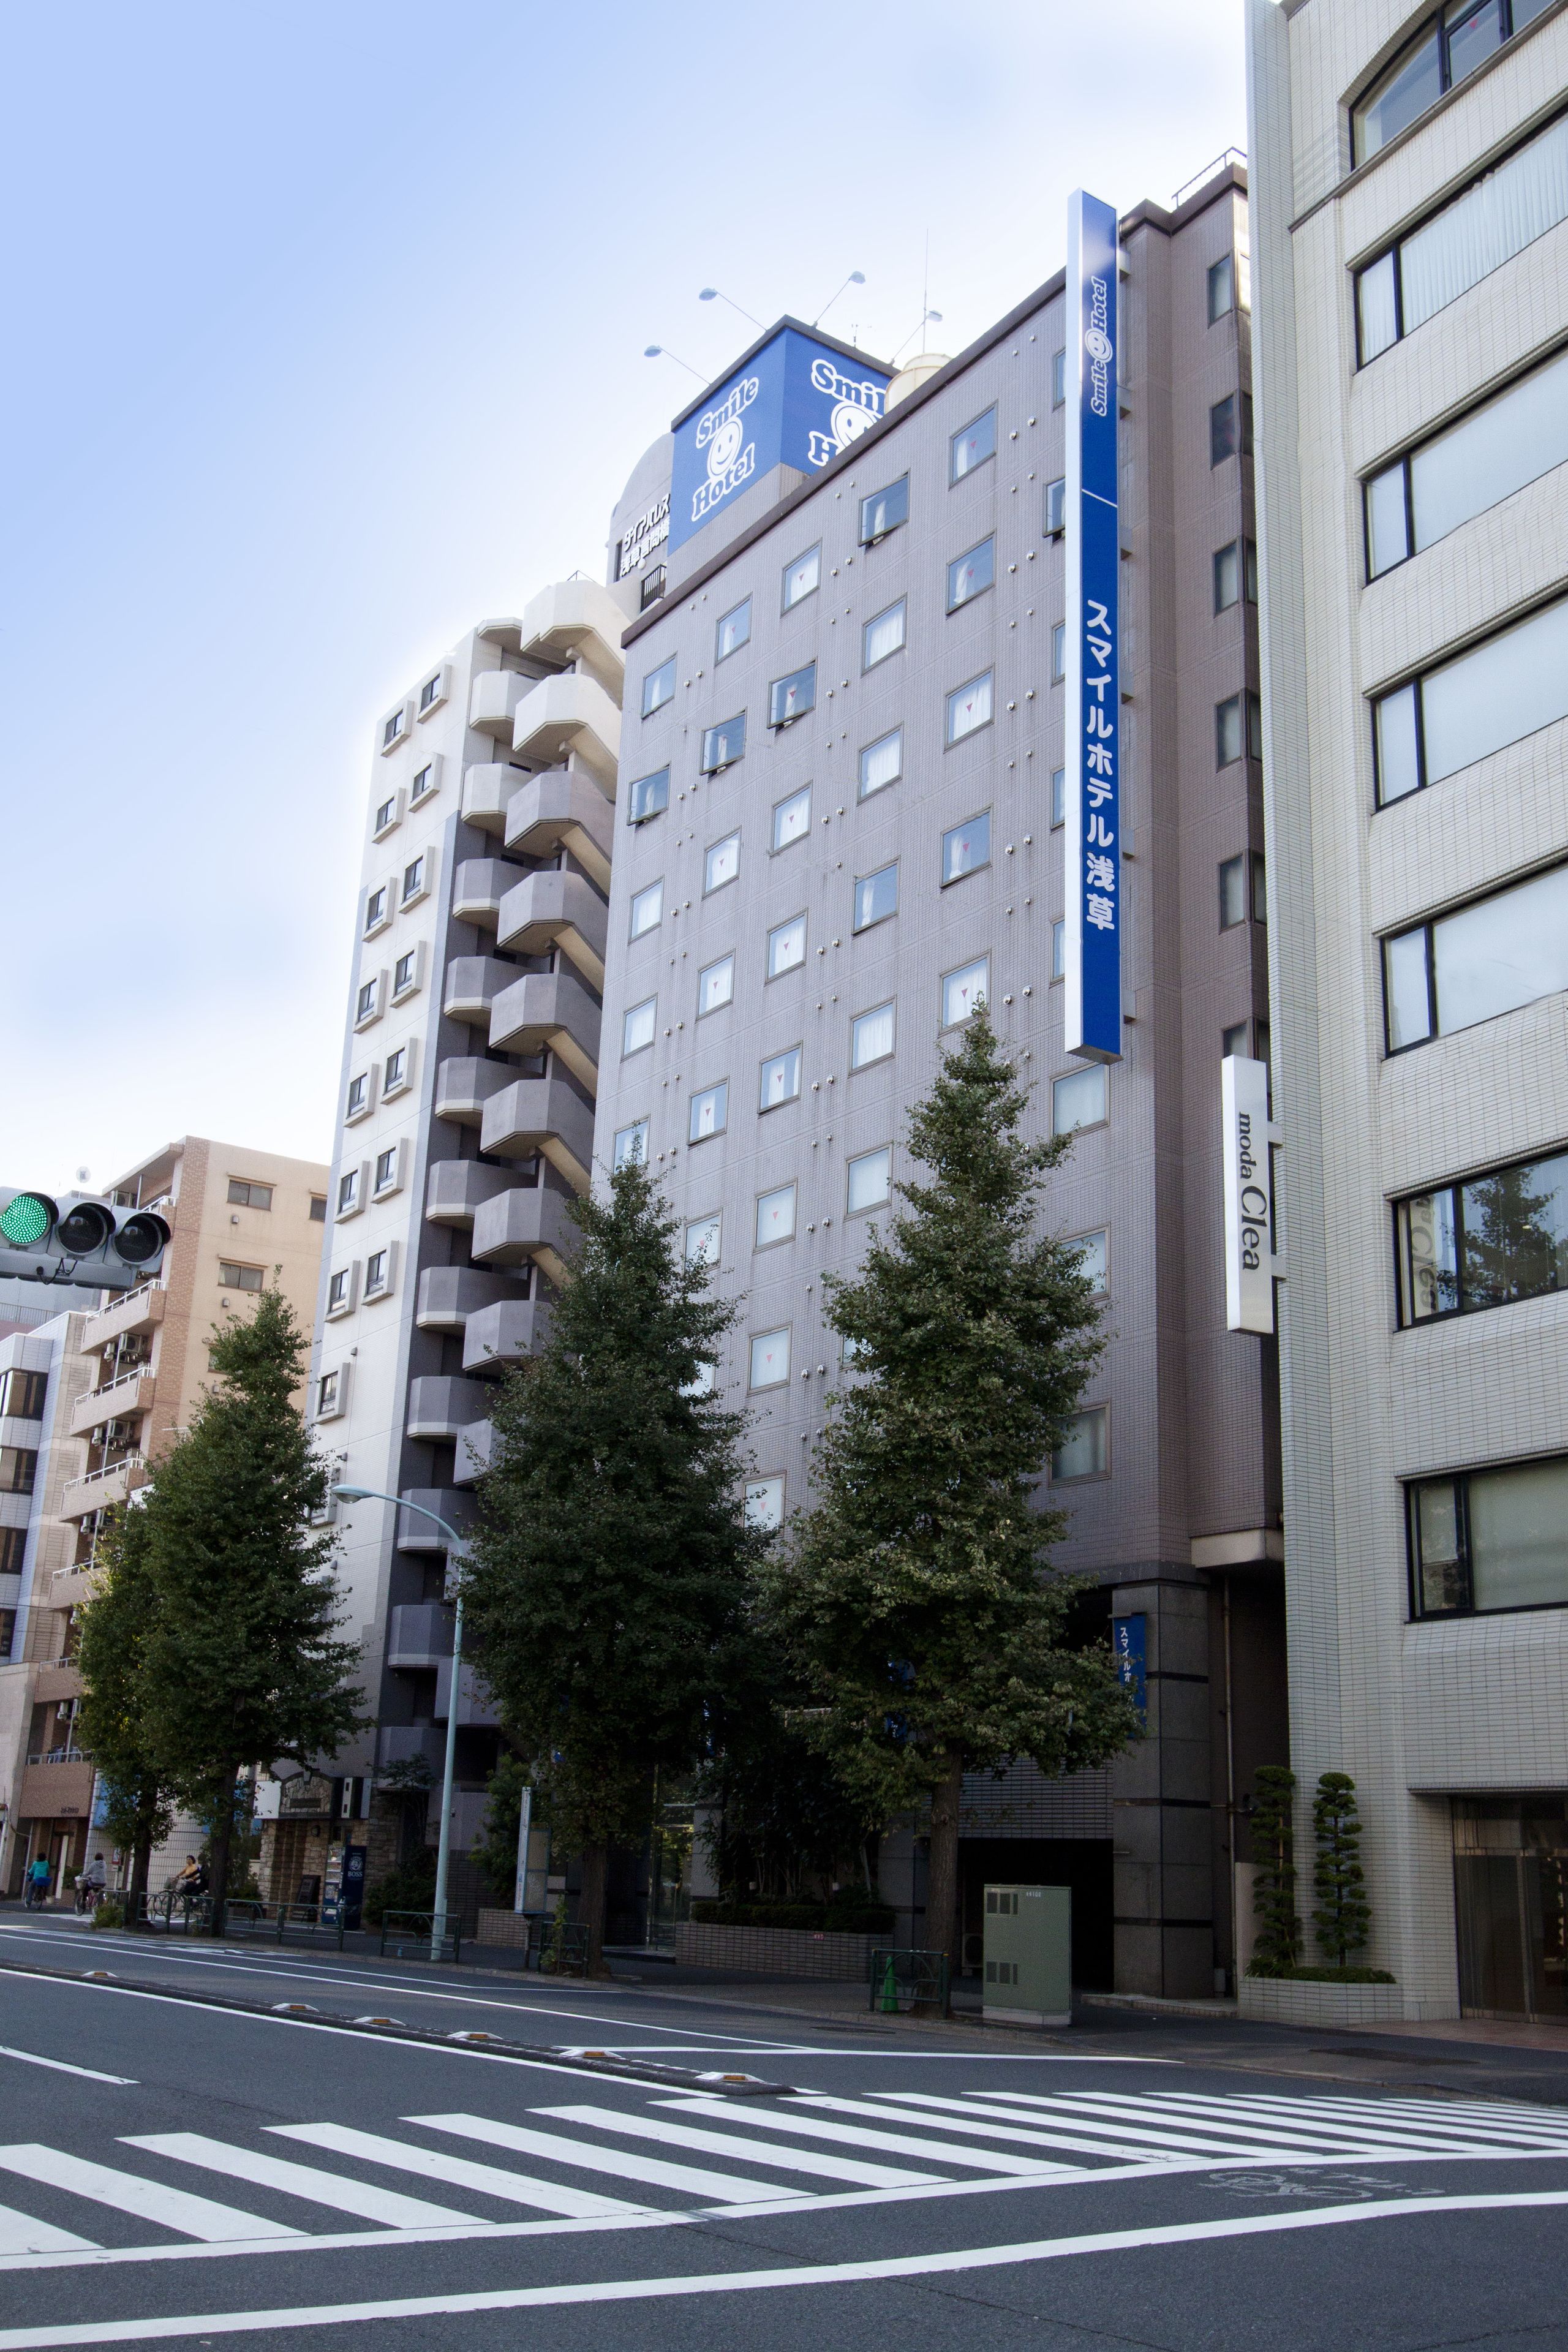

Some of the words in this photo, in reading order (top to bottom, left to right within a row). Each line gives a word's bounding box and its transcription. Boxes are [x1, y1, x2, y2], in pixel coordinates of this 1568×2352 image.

[1090, 276, 1107, 336] Hotel
[696, 377, 760, 448] Smile
[811, 359, 886, 420] Smil
[1090, 359, 1107, 417] Smile
[692, 442, 755, 521] Hotel
[624, 492, 671, 552] ダイアパレス
[1086, 599, 1115, 931] スマイルホテル浅草
[1239, 1111, 1257, 1179] moda
[1241, 1185, 1268, 1270] Clea
